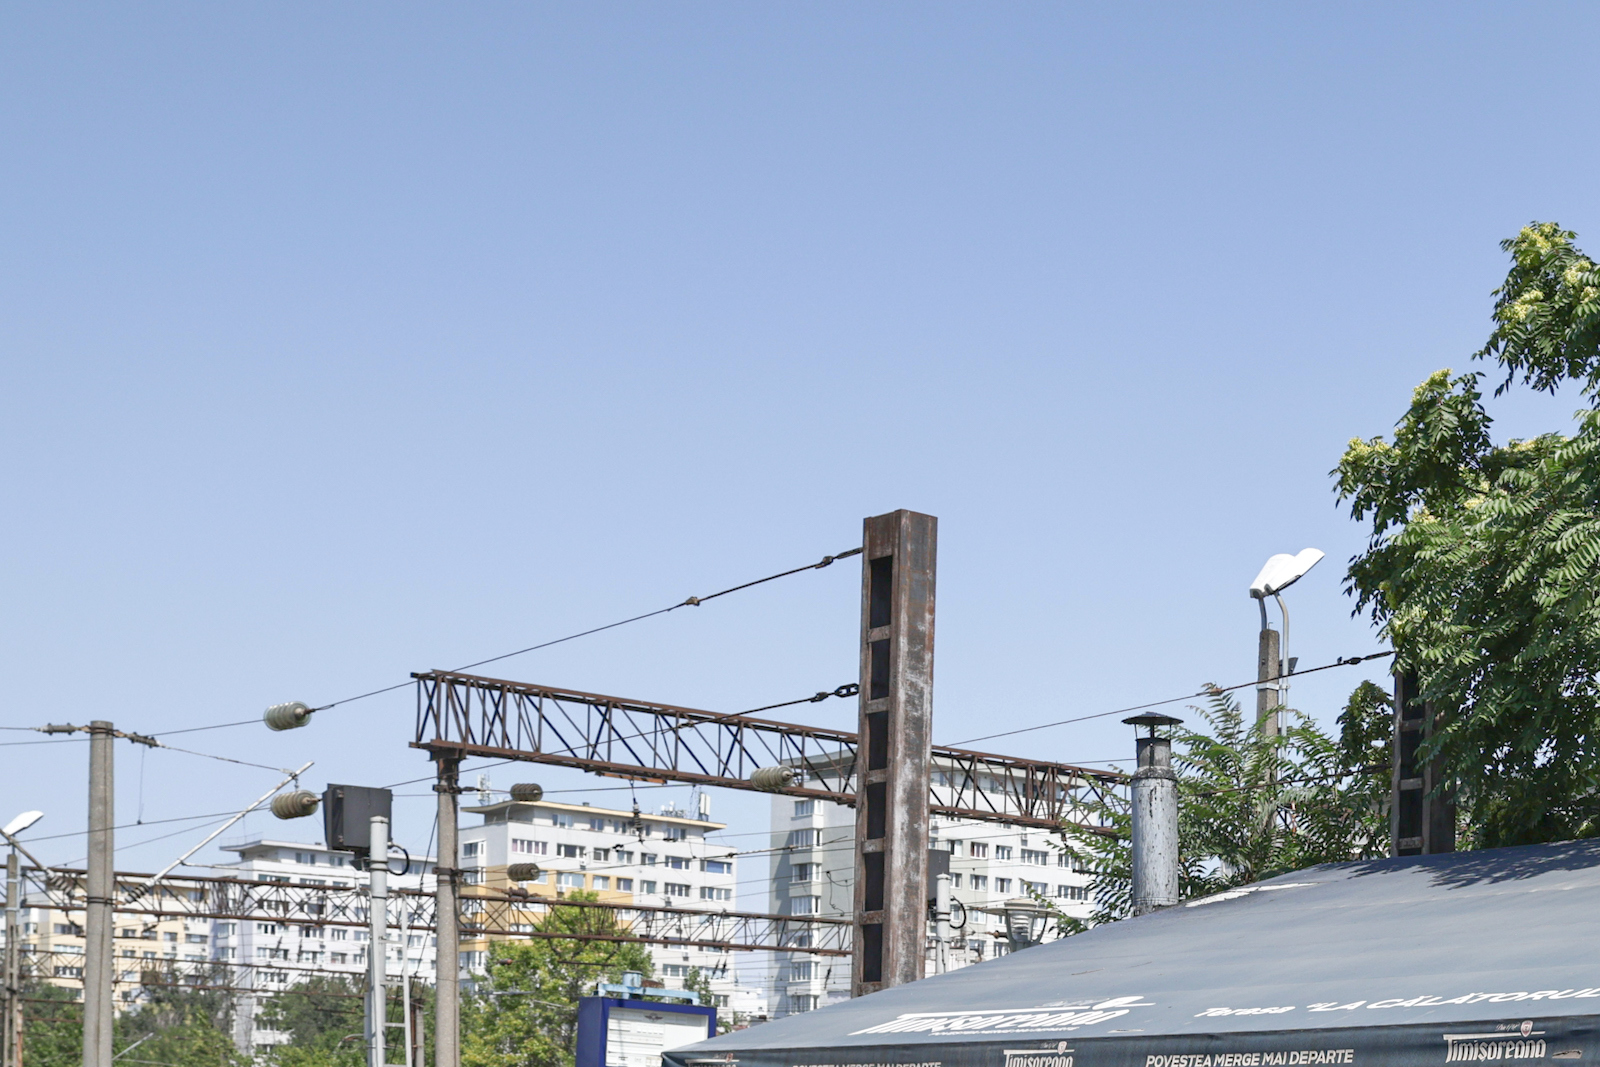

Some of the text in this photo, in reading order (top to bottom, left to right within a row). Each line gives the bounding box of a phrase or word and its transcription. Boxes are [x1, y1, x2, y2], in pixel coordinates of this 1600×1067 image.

[1145, 1049, 1354, 1067] POVESTEA MERGE MAI DEPARTE
[1443, 1031, 1546, 1063] Timișoreana
